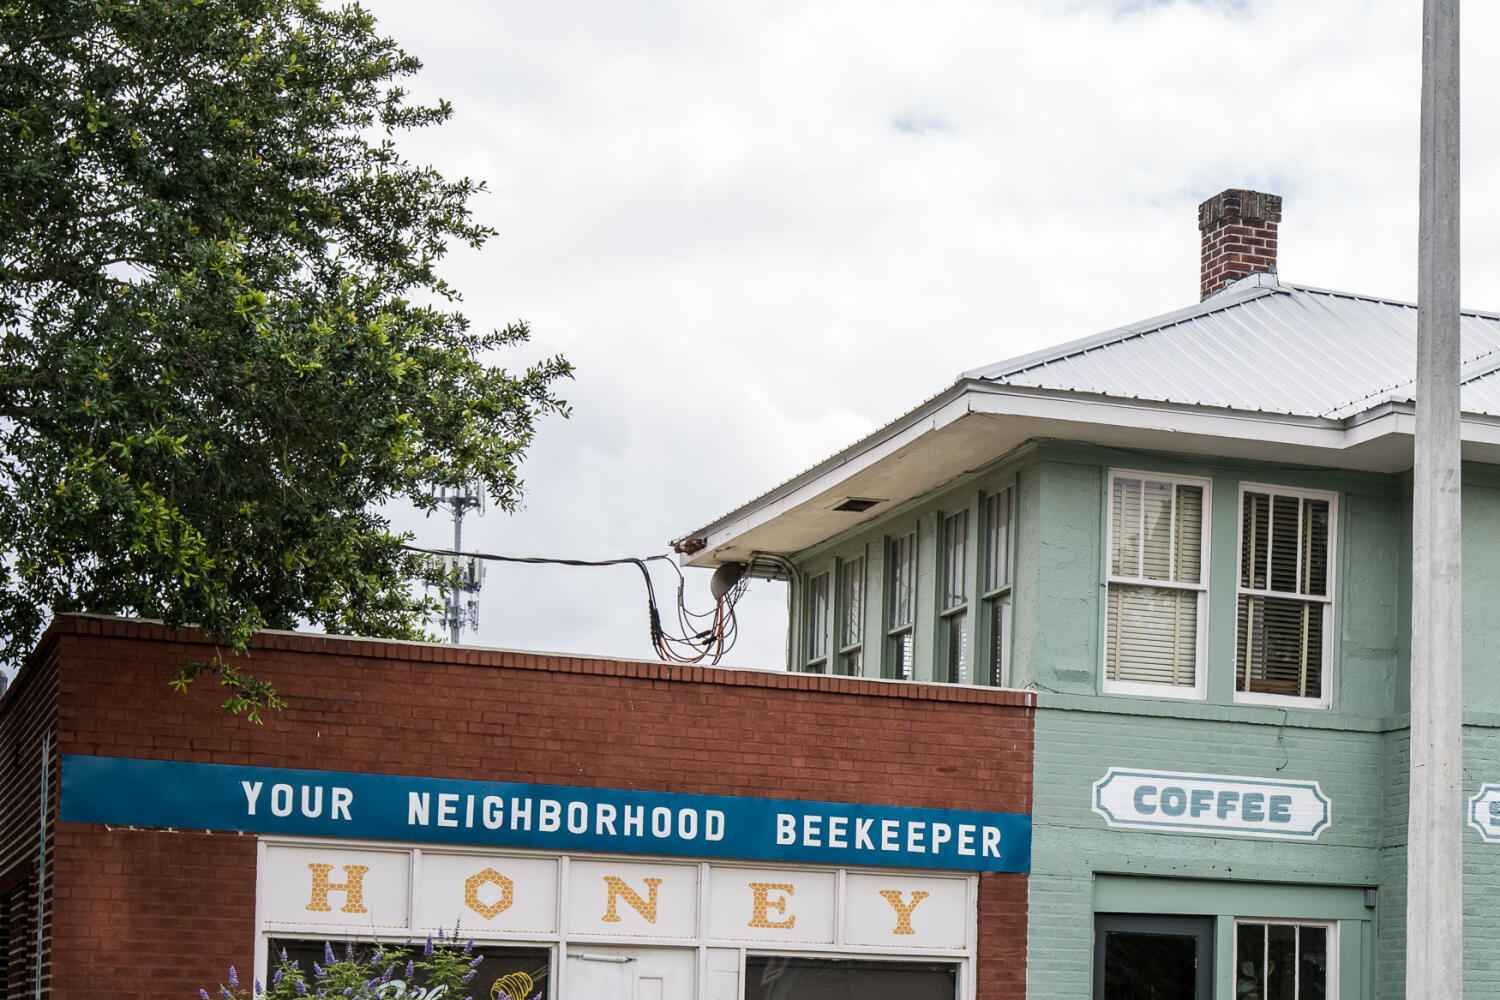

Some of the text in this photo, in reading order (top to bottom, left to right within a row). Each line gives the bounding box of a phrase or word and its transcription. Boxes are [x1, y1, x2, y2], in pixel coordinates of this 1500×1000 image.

[241, 781, 1002, 858] YOUR NEIGHBORHOOD BEEKEEPER
[1133, 785, 1292, 823] COFFEE
[305, 862, 929, 935] HONEY
